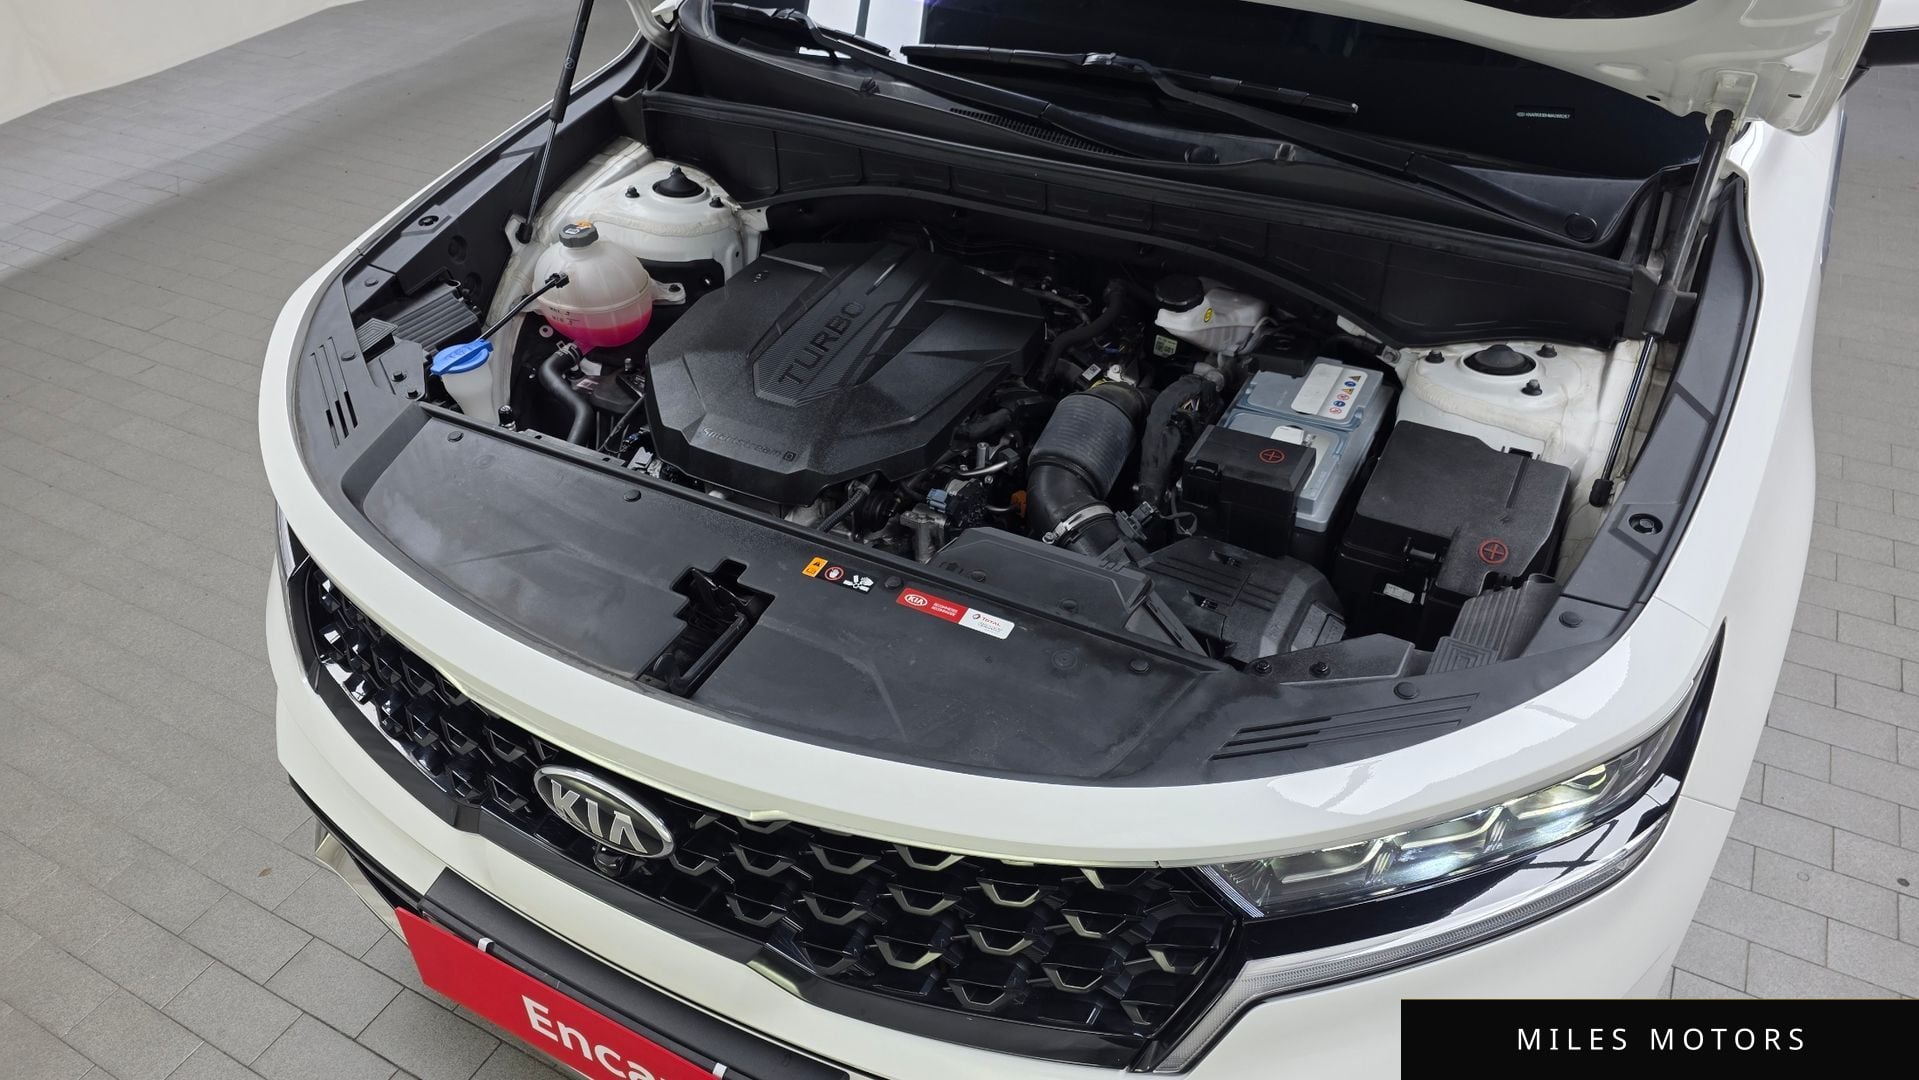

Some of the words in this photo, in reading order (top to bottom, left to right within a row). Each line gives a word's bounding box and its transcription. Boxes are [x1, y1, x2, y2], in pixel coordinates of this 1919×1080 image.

[778, 301, 865, 384] TURBO
[909, 595, 924, 605] KIA
[551, 779, 648, 854] KIA
[521, 995, 666, 1080] Enca
